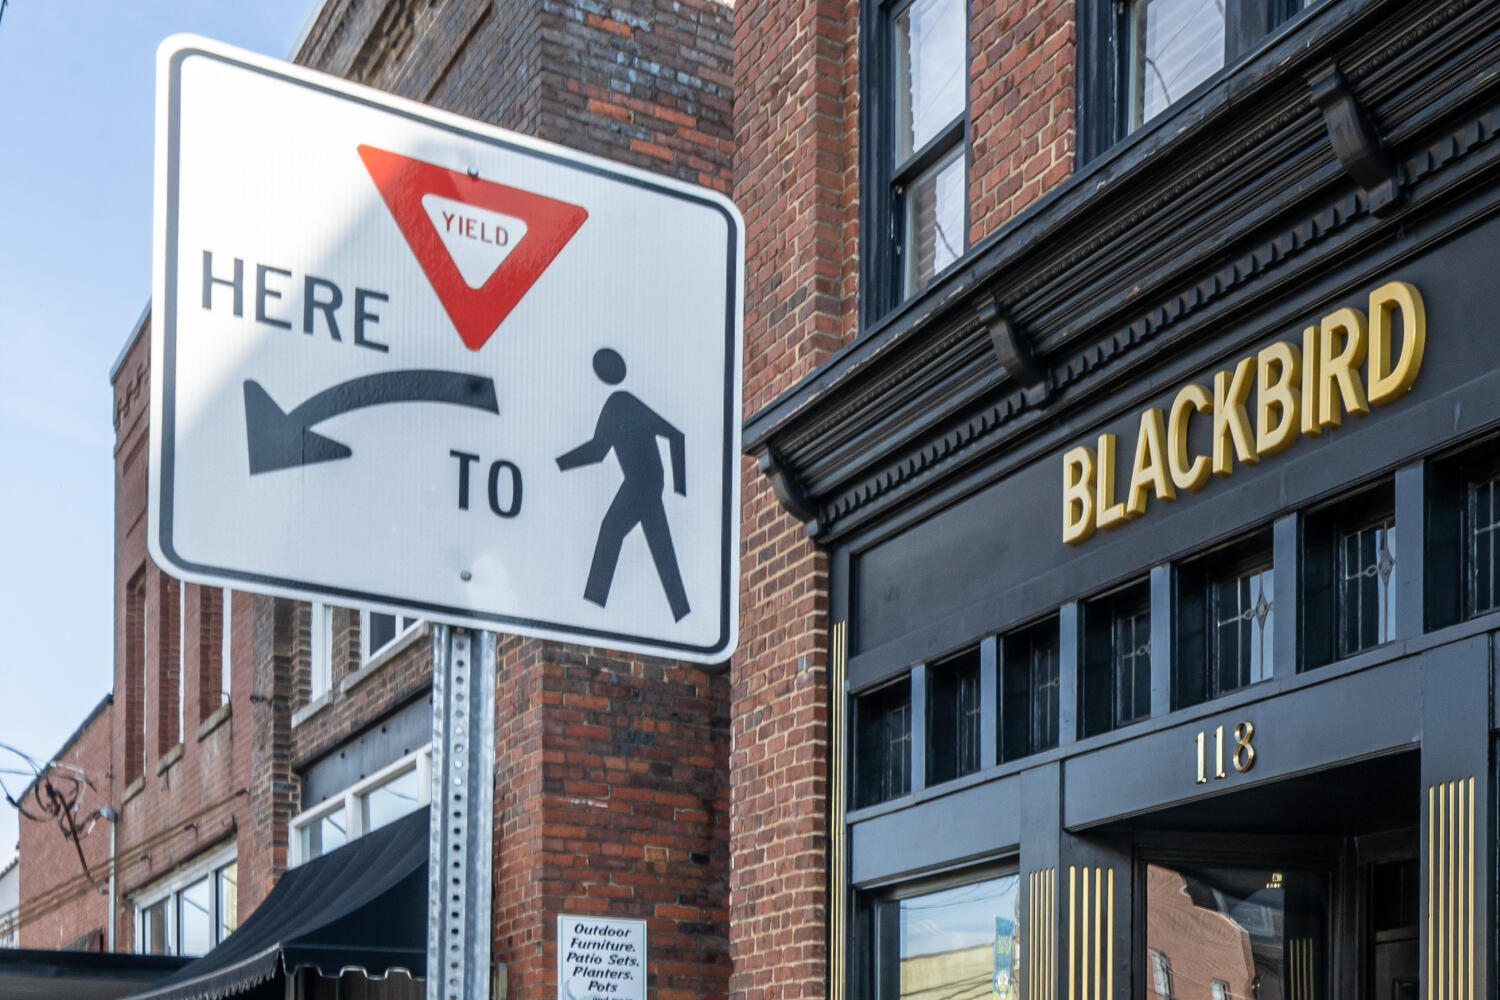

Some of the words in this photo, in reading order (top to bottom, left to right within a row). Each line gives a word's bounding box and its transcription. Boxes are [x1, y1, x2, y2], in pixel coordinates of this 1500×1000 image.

[442, 210, 509, 247] YIELD
[202, 249, 389, 354] HERE
[1062, 280, 1427, 546] BLACKBIRD
[449, 448, 523, 519] TO
[1194, 721, 1255, 785] 118
[574, 923, 631, 938] Outdoor
[566, 952, 602, 965] Patio
[587, 981, 617, 993] Pots
